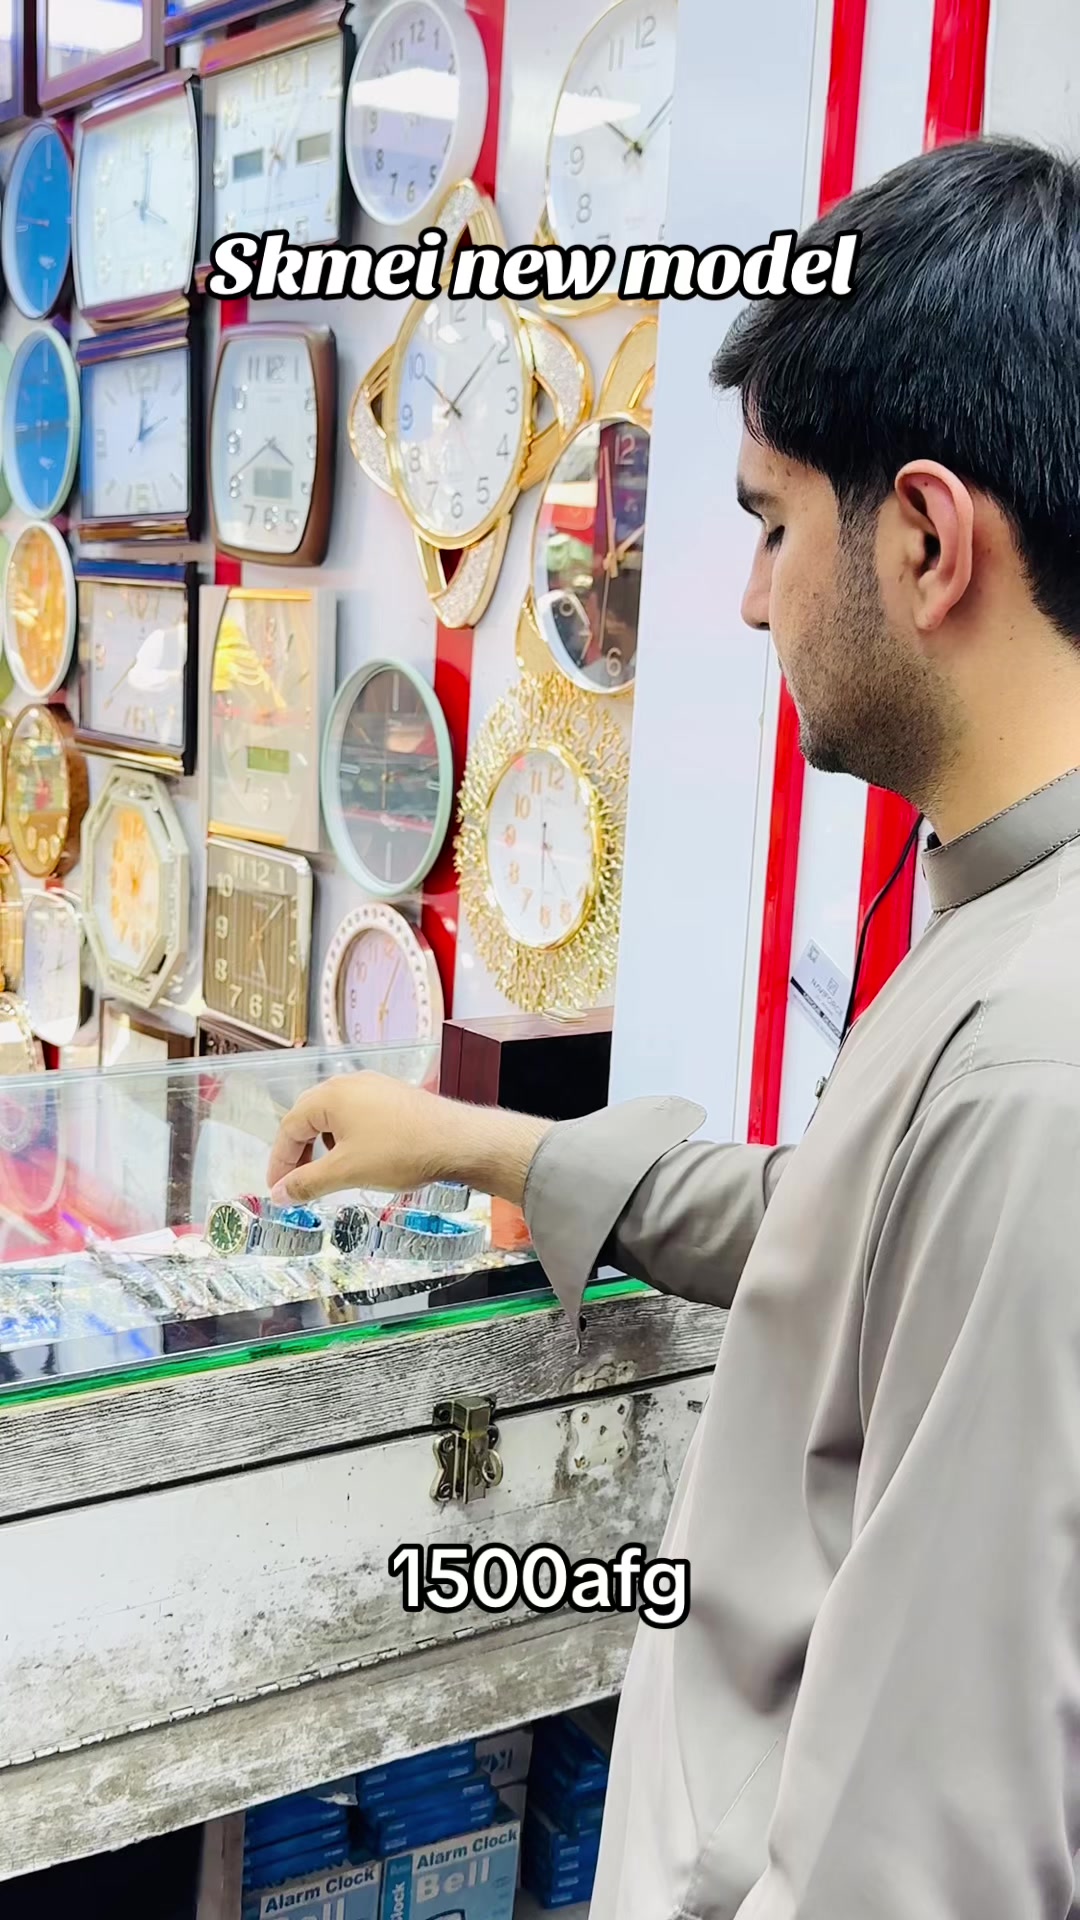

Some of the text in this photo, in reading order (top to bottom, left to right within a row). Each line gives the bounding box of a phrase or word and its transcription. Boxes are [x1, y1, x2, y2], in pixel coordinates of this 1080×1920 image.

[409, 19, 426, 44] 12
[433, 28, 440, 50] 1
[634, 15, 656, 51] 12
[391, 38, 406, 63] 11
[607, 35, 625, 72] 11
[375, 148, 385, 172] 8
[569, 145, 585, 176] 9
[389, 171, 399, 197] 7
[406, 179, 417, 204] 6
[428, 165, 438, 190] 5
[575, 192, 593, 224] 8
[266, 355, 286, 382] 12
[408, 352, 426, 380] 10
[504, 386, 519, 415] 3
[400, 404, 414, 431] 9
[408, 446, 422, 473] 8
[495, 433, 511, 461] 4
[614, 433, 636, 465] 12
[426, 480, 439, 507] 7
[476, 476, 490, 505] 5
[242, 504, 257, 527] 7
[285, 508, 300, 534] 5
[450, 491, 463, 519] 6
[605, 646, 622, 677] 6
[531, 770, 543, 795] 11
[547, 764, 565, 790] 12
[514, 793, 531, 820] 10
[216, 871, 234, 898] 10
[233, 855, 286, 892] 11 12 1
[521, 886, 533, 916] 7
[214, 915, 229, 940] 9
[214, 957, 228, 983] 8
[228, 983, 285, 1030] 7 6 5
[416, 1845, 468, 1870] Alarm
[472, 1829, 517, 1853] Clock
[265, 1886, 320, 1913] Alarm
[325, 1867, 375, 1894] Clock
[416, 1856, 490, 1904] Bell
